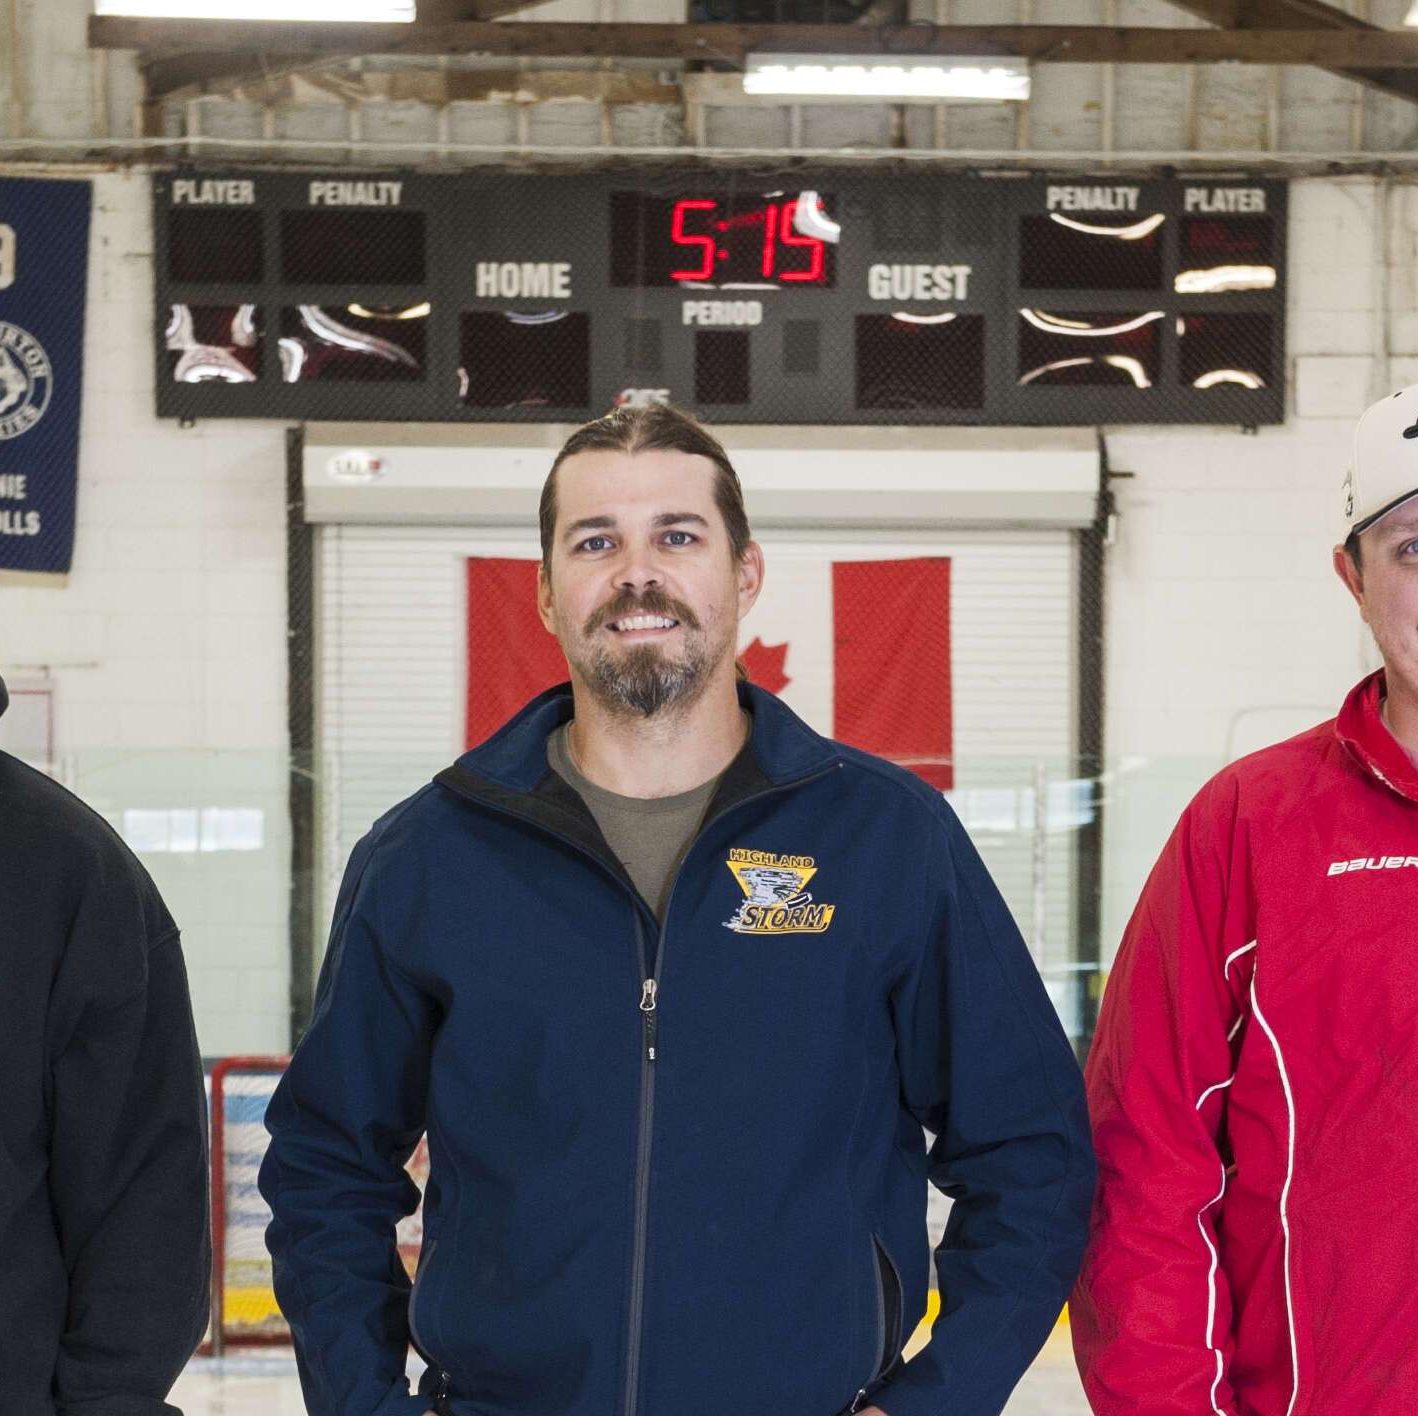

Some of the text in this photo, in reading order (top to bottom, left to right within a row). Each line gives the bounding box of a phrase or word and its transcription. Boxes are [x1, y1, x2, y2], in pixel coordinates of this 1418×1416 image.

[173, 180, 403, 206] PLAYER PENALTY
[1048, 186, 1265, 213] PENALTY PLAYER
[670, 199, 825, 281] 5:15
[476, 262, 572, 298] HOME
[868, 265, 972, 300] GUEST
[682, 300, 763, 326] PERIOD
[730, 849, 814, 868] HIGHLAND
[741, 905, 825, 929] STORM
